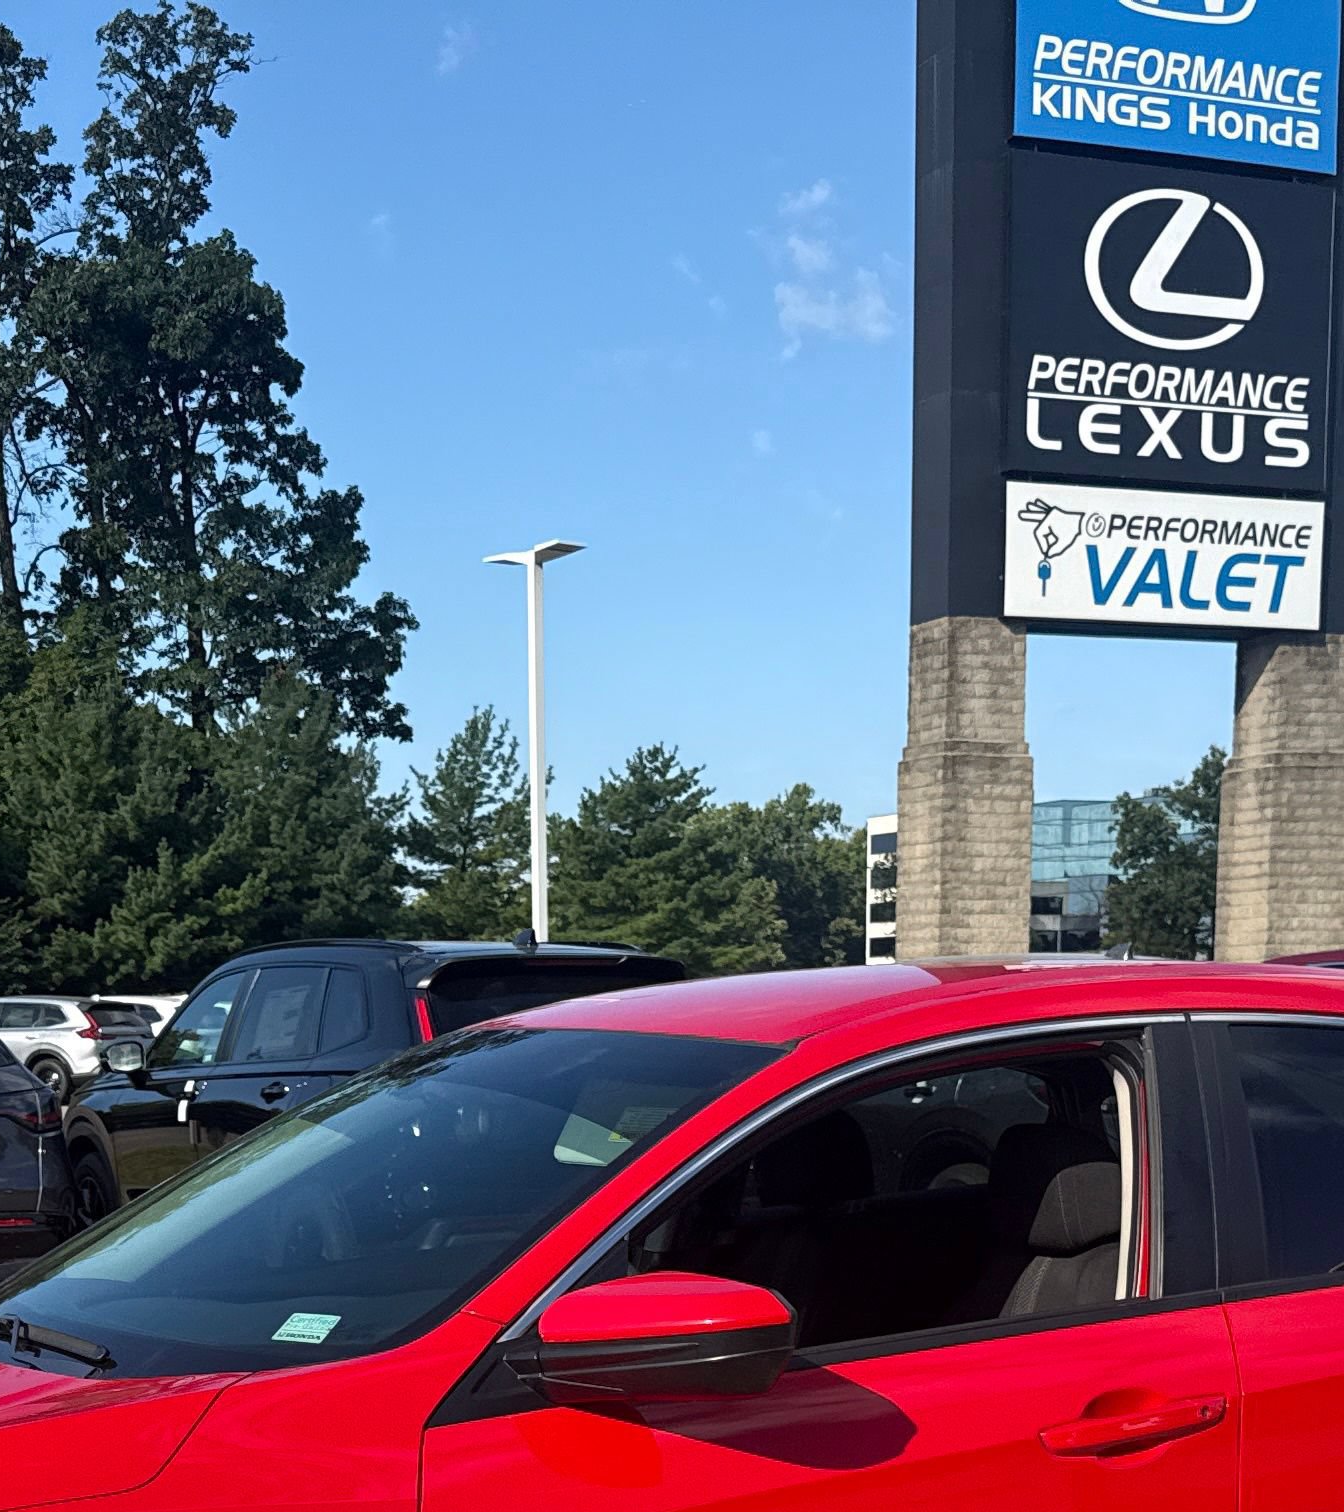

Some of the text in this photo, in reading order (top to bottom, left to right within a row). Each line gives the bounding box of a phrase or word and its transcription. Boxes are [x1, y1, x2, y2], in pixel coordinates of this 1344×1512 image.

[1034, 35, 1321, 107] PERFORMANCE
[1032, 83, 1320, 151] KINGS Honda
[1028, 355, 1310, 412] PERFORMANCE
[1027, 399, 1310, 467] LEXUS
[1108, 514, 1313, 549] PERFORMANCE
[1085, 545, 1306, 613] VALET
